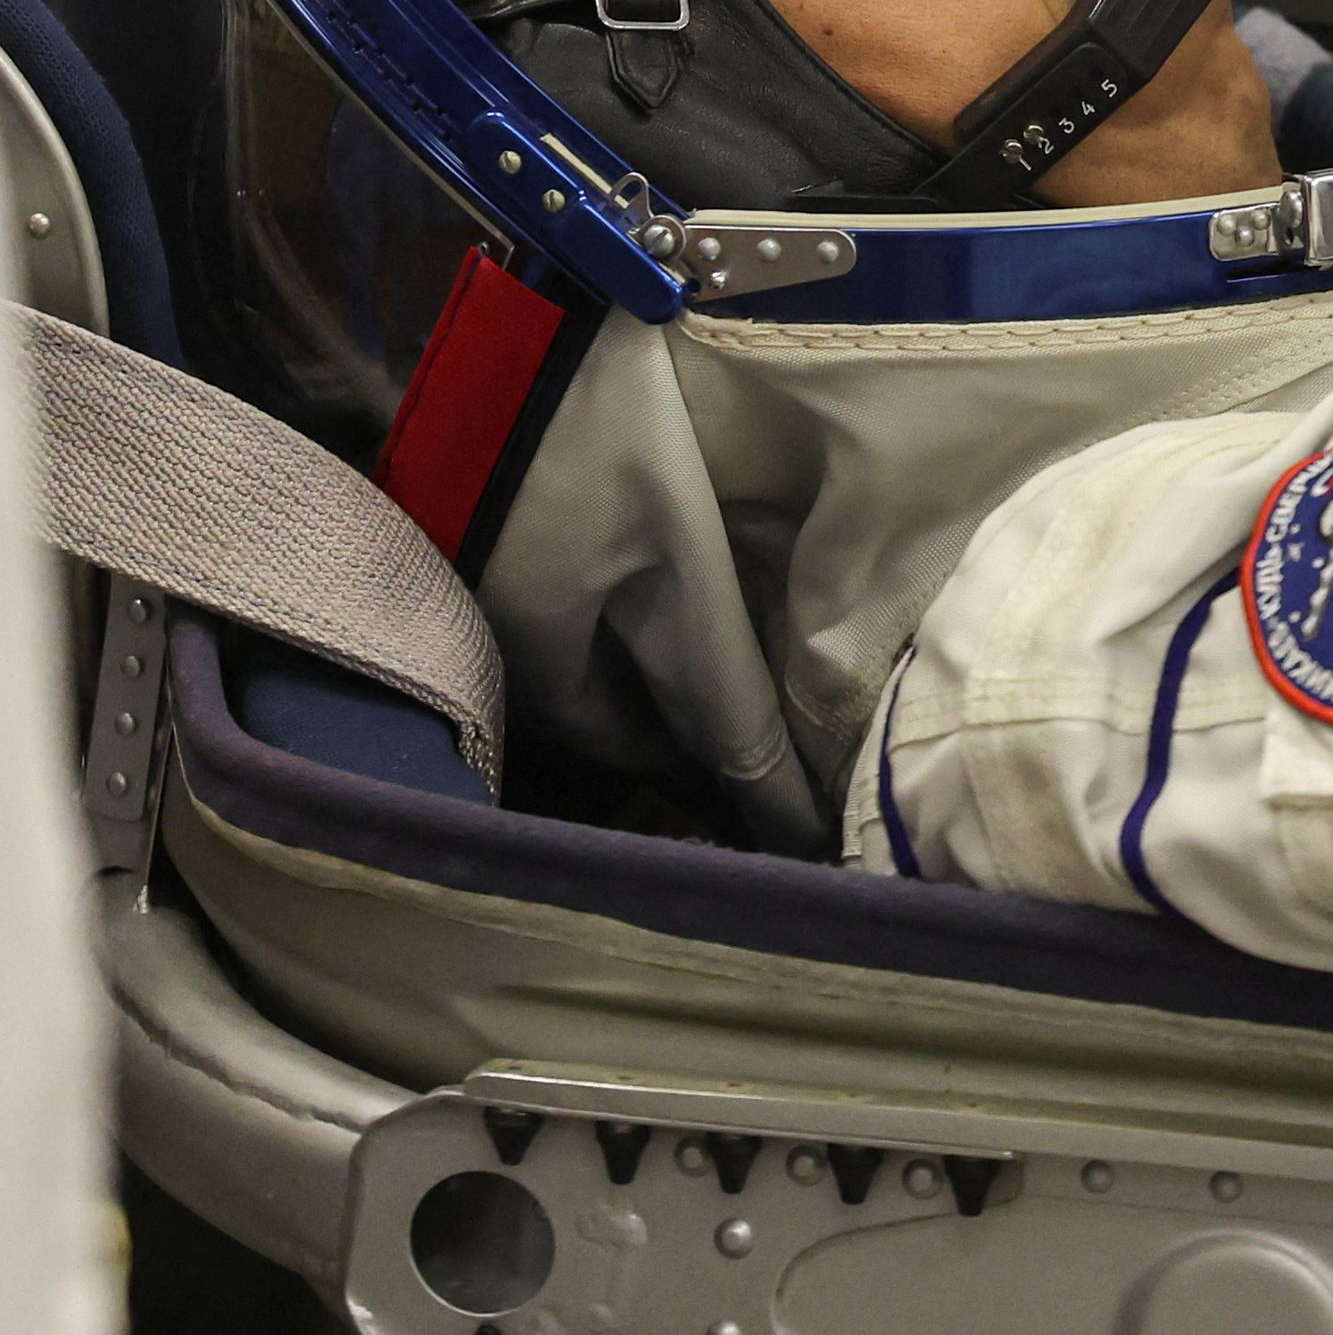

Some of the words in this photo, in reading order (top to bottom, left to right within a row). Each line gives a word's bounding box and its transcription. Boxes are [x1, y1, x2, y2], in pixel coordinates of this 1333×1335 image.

[1038, 136, 1055, 155] 2
[1058, 117, 1075, 134] 3
[1081, 100, 1096, 115] 4
[1101, 79, 1118, 98] 5
